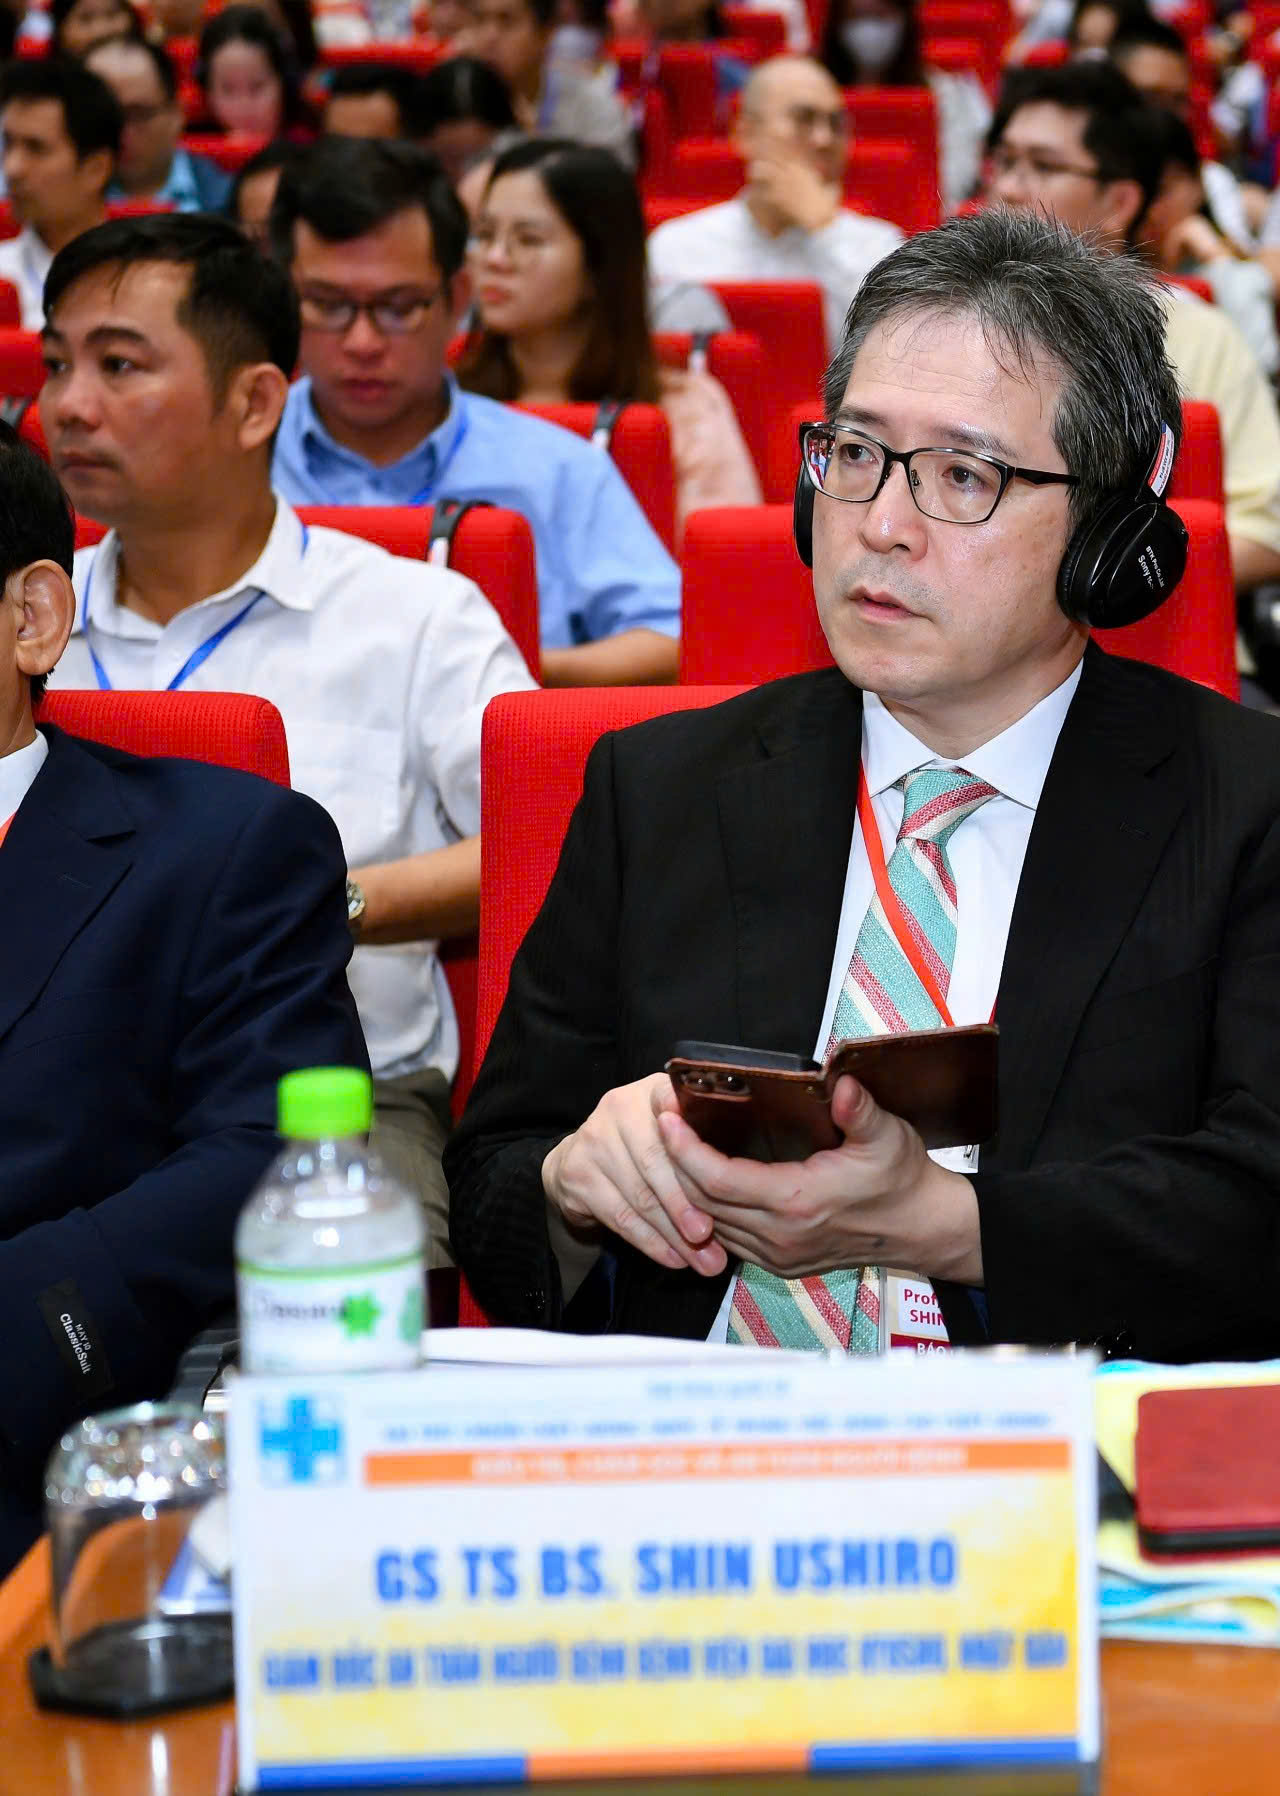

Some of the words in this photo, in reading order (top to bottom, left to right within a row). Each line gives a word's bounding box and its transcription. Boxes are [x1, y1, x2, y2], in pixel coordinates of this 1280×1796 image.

[1138, 555, 1150, 577] Sony
[60, 1313, 91, 1374] ClassicSuit
[75, 1323, 89, 1341] MAY
[83, 1341, 92, 1351] 10
[376, 1547, 439, 1601] GS
[460, 1544, 519, 1599] TS
[637, 1539, 753, 1594] SHIN
[774, 1535, 959, 1591] USHIRO
